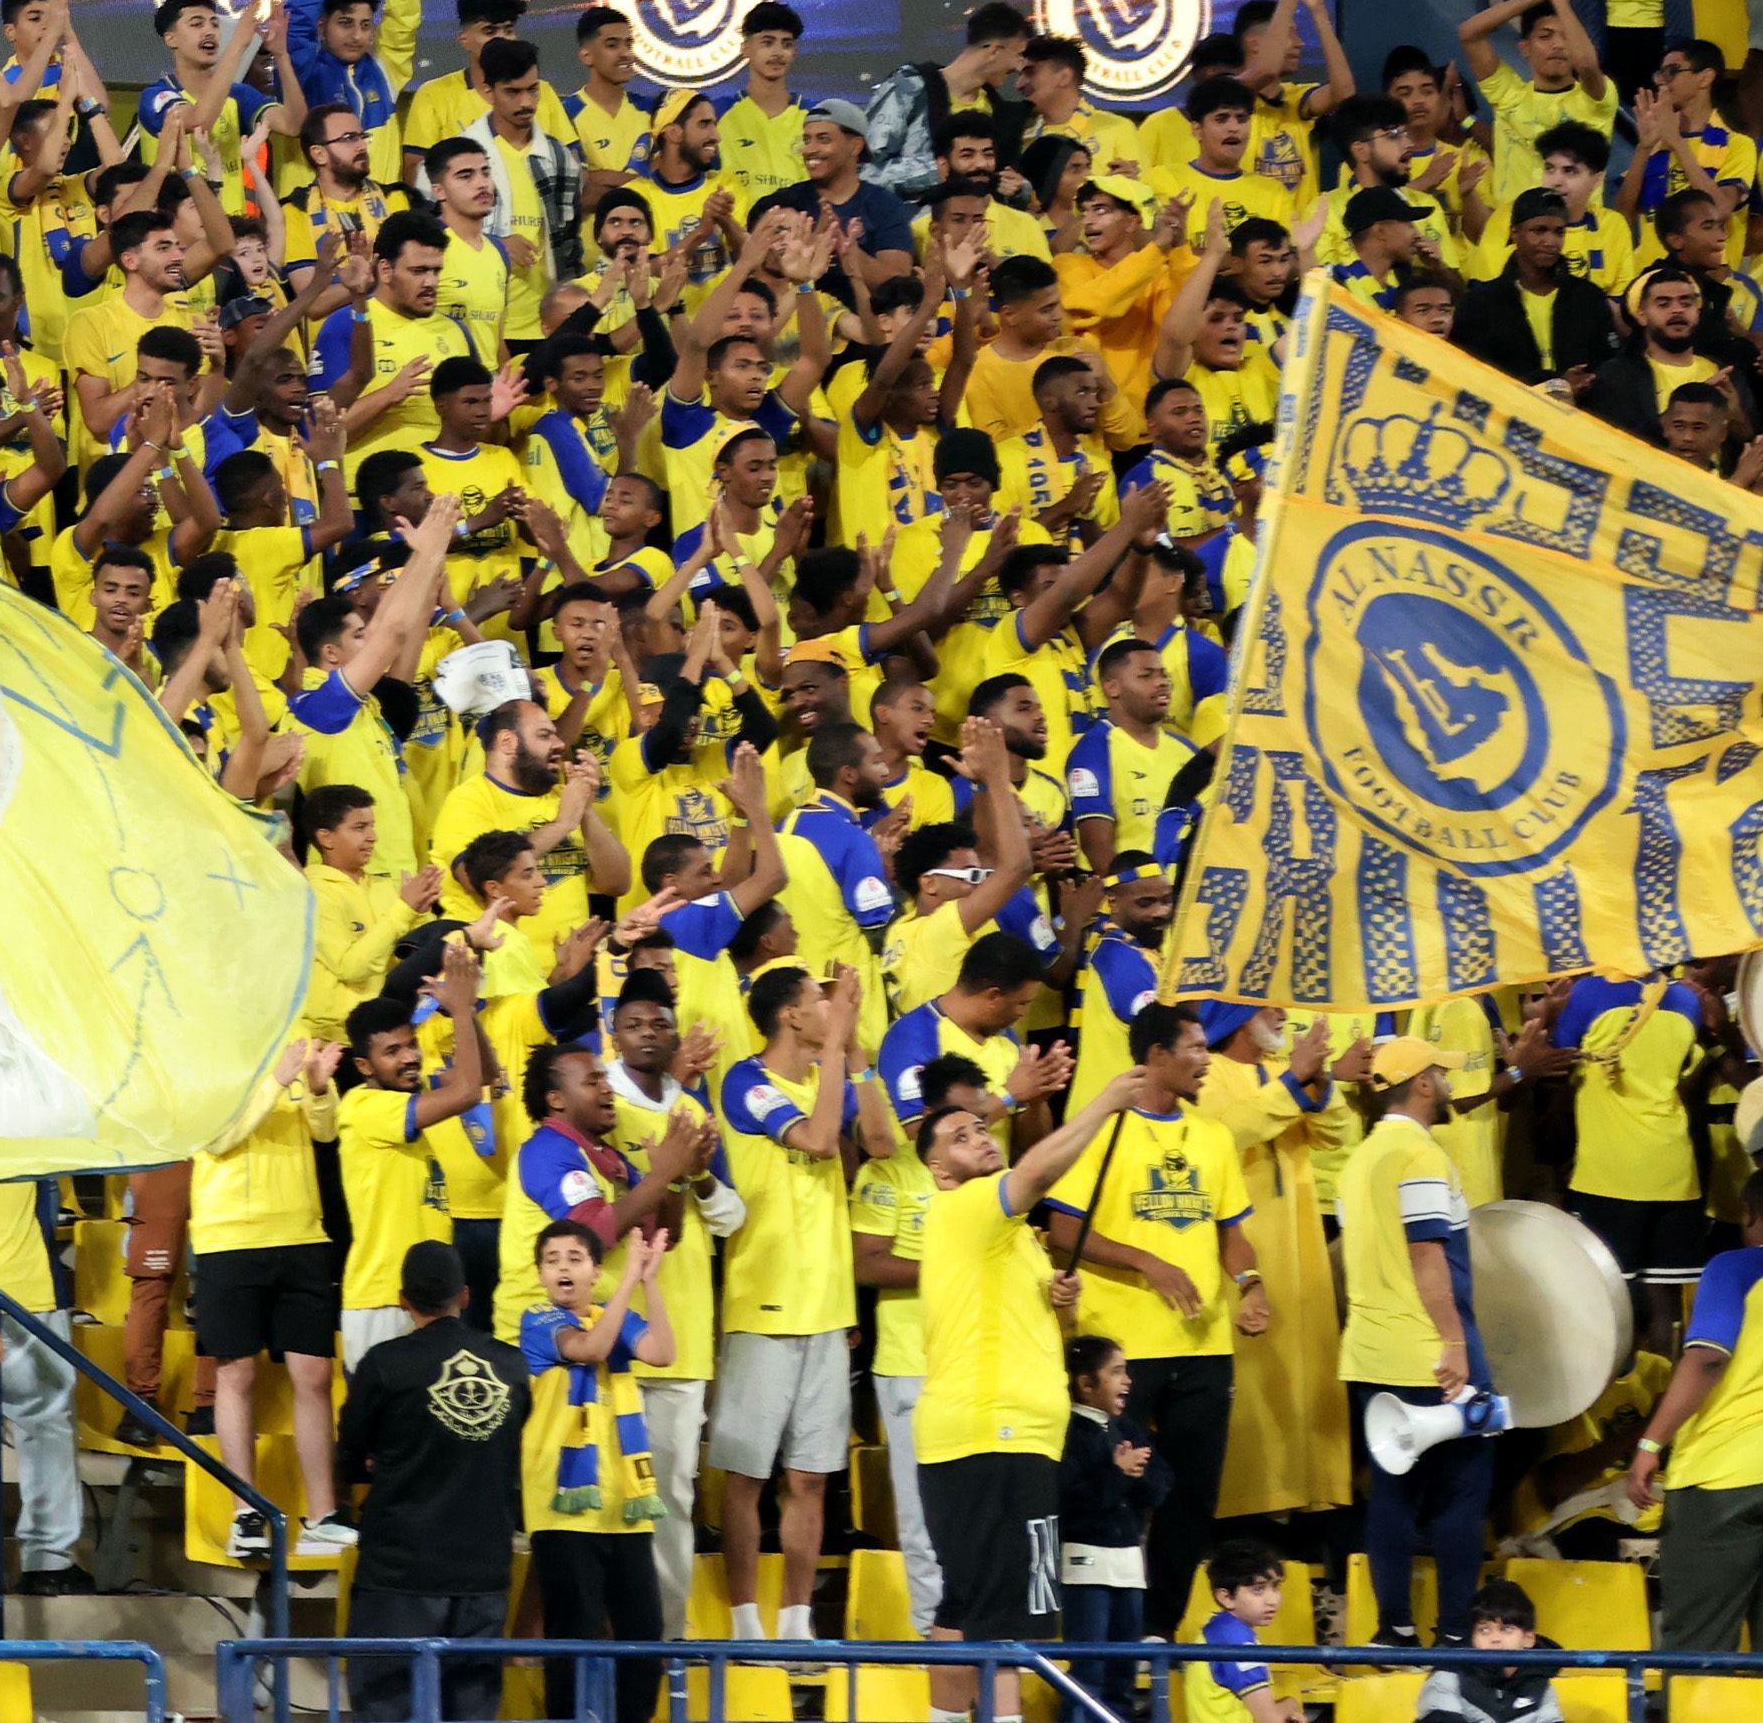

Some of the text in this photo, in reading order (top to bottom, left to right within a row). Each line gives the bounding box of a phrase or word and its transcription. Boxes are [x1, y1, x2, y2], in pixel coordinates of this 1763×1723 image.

[1329, 544, 1537, 652] AL NASSR
[1341, 745, 1584, 851] FOOTBALL CLUB
